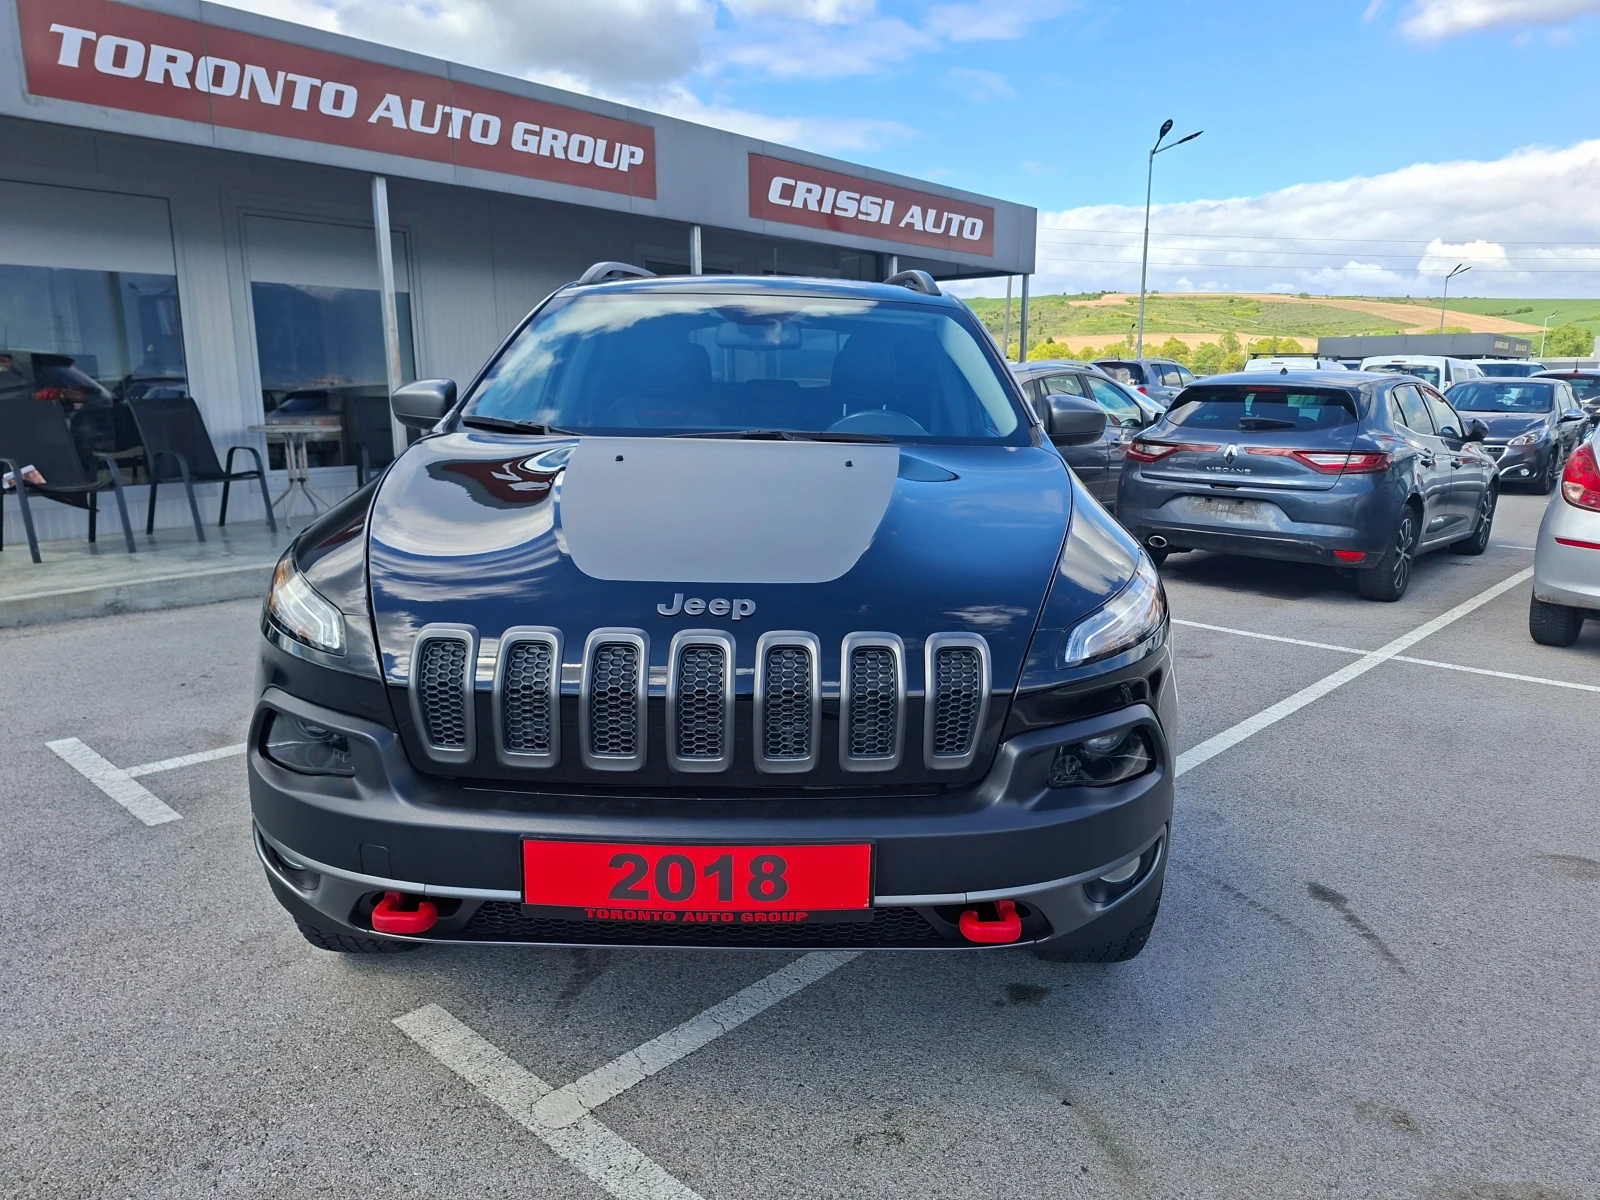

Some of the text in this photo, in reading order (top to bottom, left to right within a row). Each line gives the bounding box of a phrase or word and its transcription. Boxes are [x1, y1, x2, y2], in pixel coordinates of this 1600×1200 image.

[49, 23, 645, 172] TORONTO AUTO GROUP
[767, 176, 984, 241] CRISSI AUTO
[656, 593, 756, 621] Jeep
[607, 852, 789, 902] 2018
[585, 908, 809, 923] TORONTO AUTO GROUP
